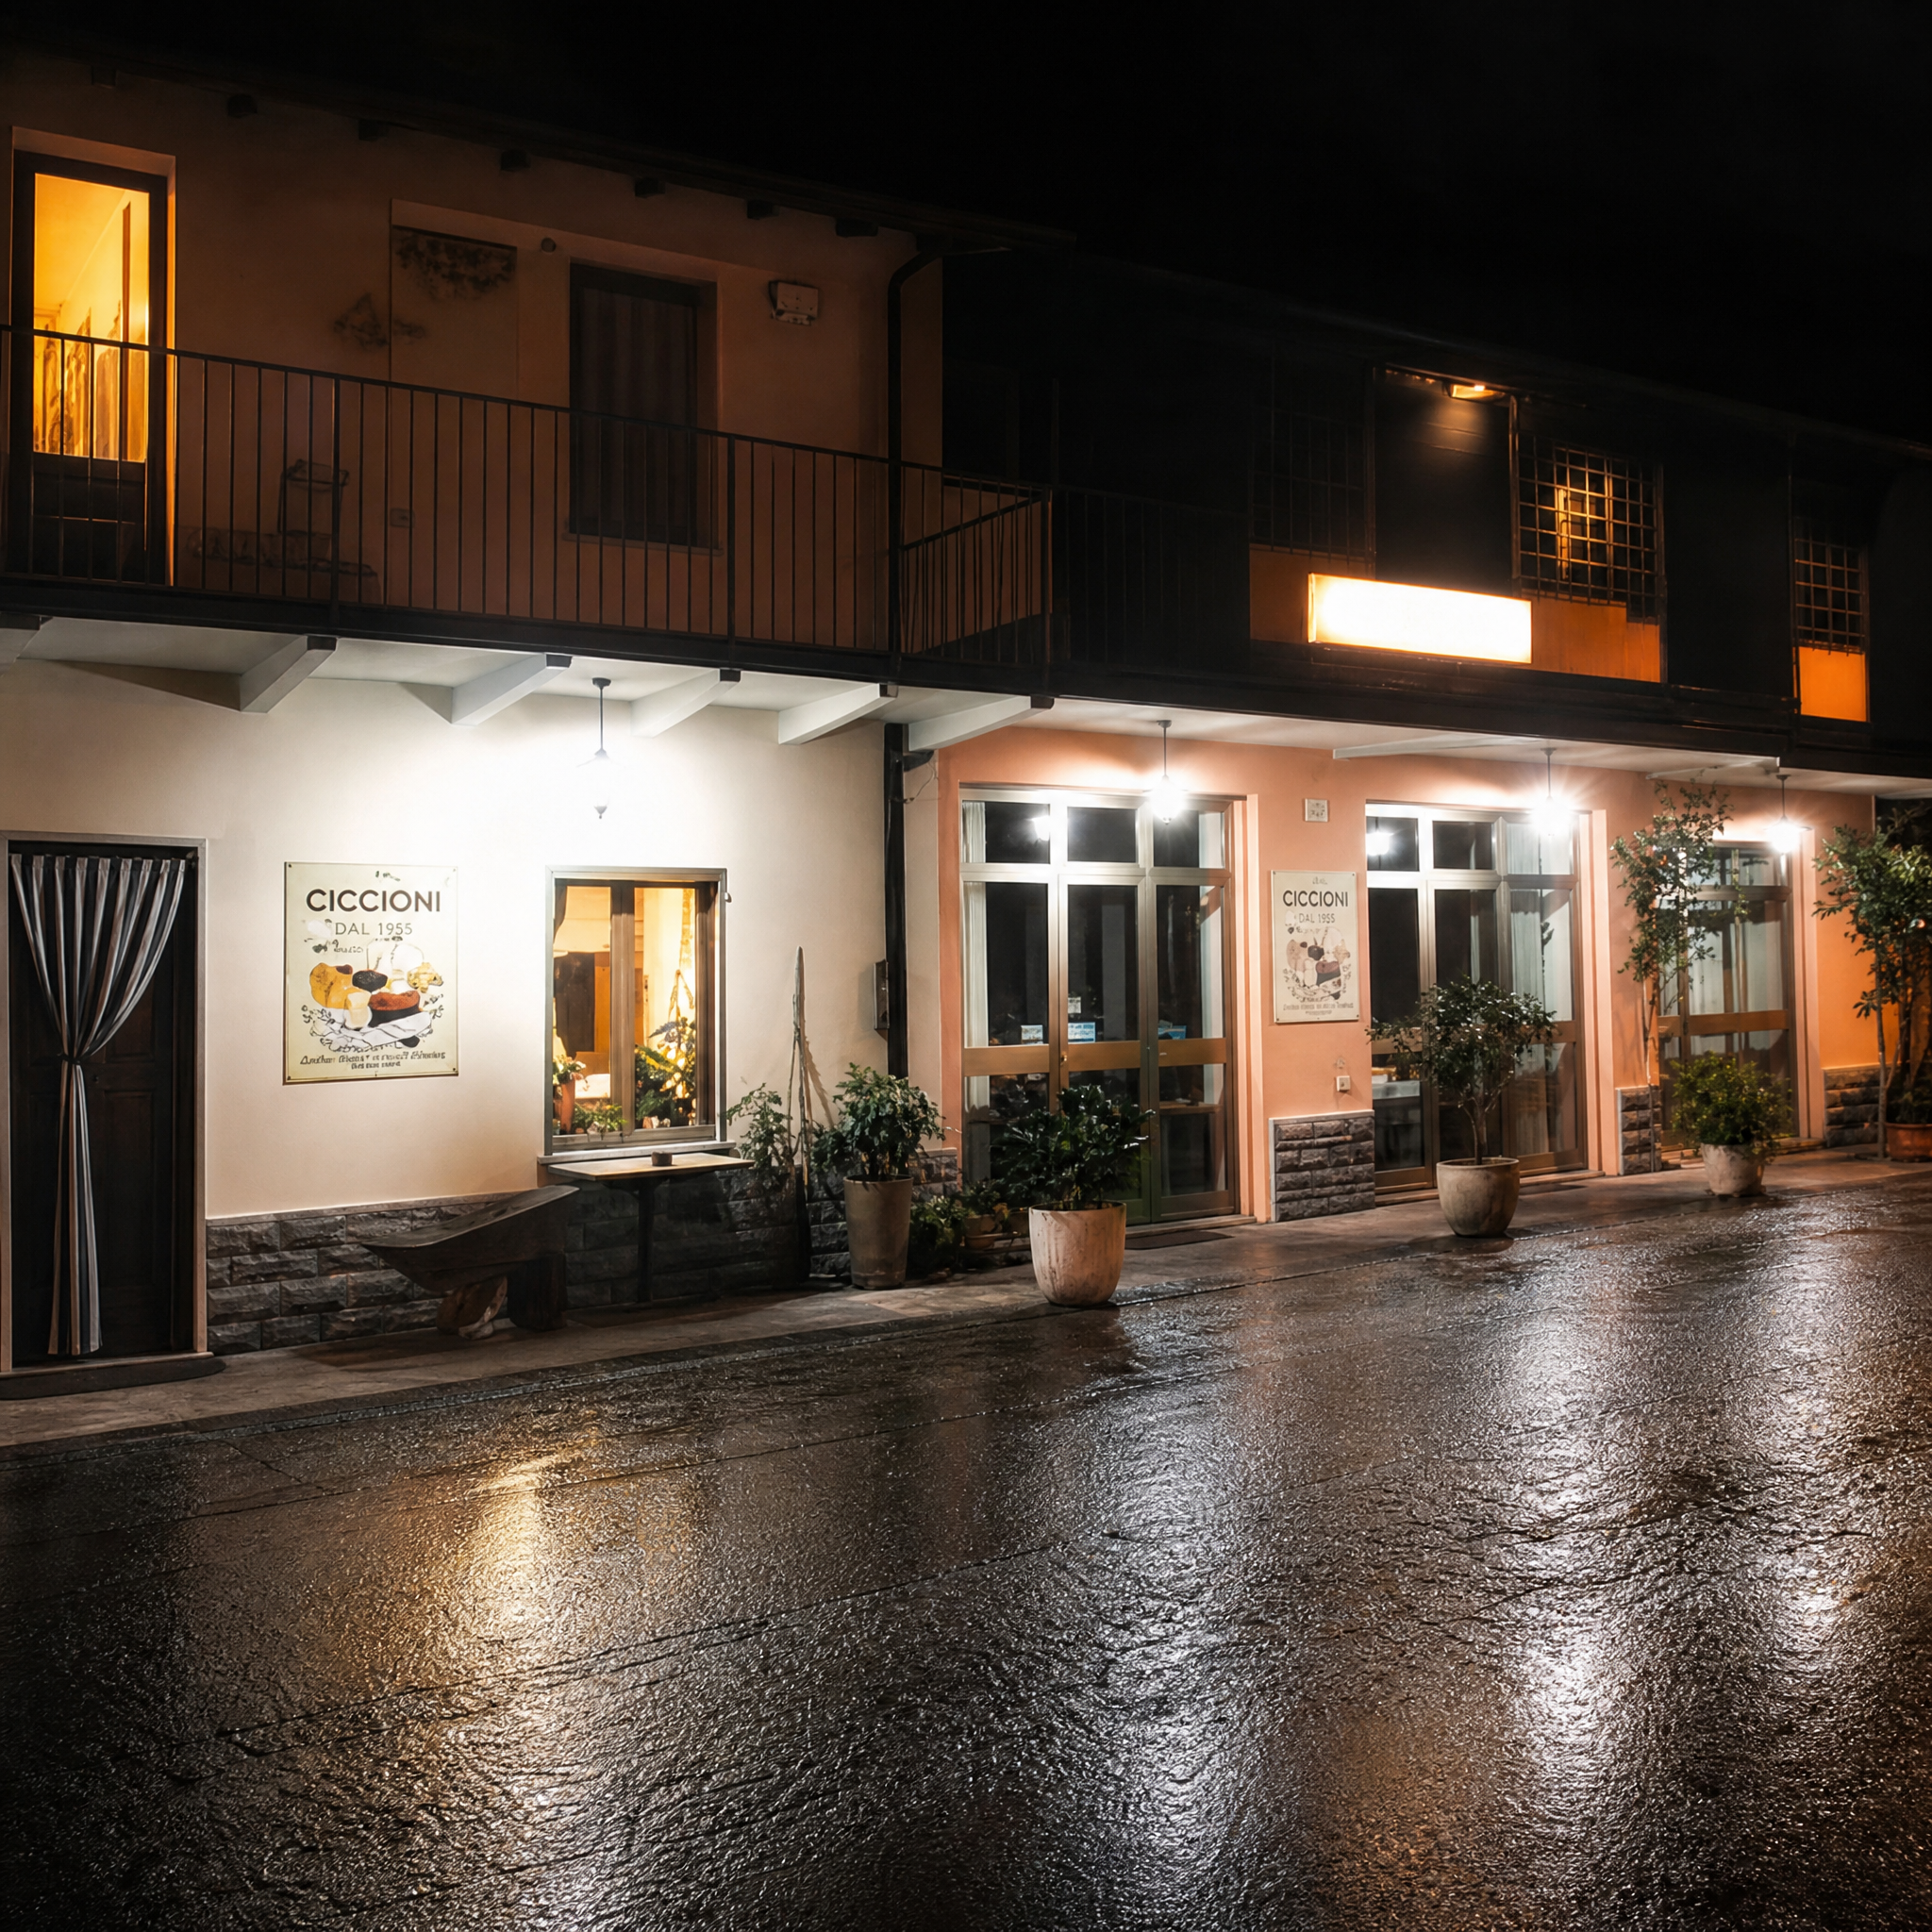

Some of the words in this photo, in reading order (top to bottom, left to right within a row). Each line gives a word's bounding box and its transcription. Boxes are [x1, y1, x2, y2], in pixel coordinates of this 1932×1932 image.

[306, 889, 441, 912] CICCIONI
[1283, 890, 1348, 907] CICCIONI
[1299, 913, 1315, 924] DAL
[1318, 913, 1336, 924] 1955
[335, 923, 370, 935] DAL
[377, 923, 413, 936] 1955
